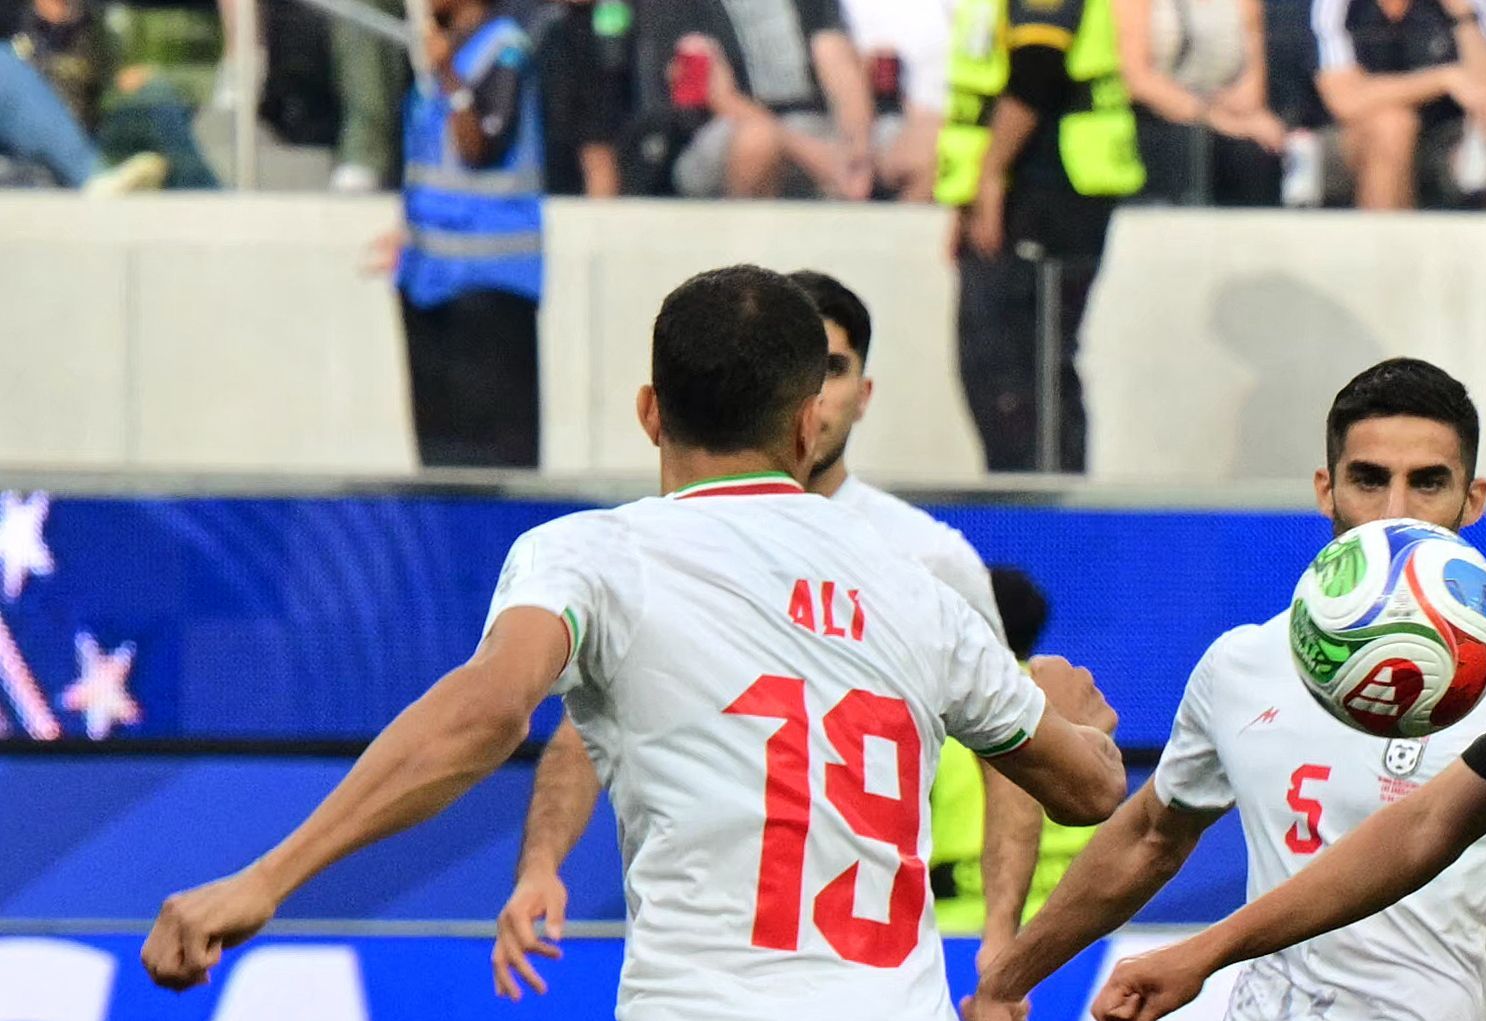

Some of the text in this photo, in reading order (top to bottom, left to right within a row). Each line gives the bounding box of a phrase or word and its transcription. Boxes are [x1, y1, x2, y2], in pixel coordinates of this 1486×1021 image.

[788, 579, 866, 641] ALI
[722, 674, 927, 968] 19
[1285, 764, 1332, 854] 5
